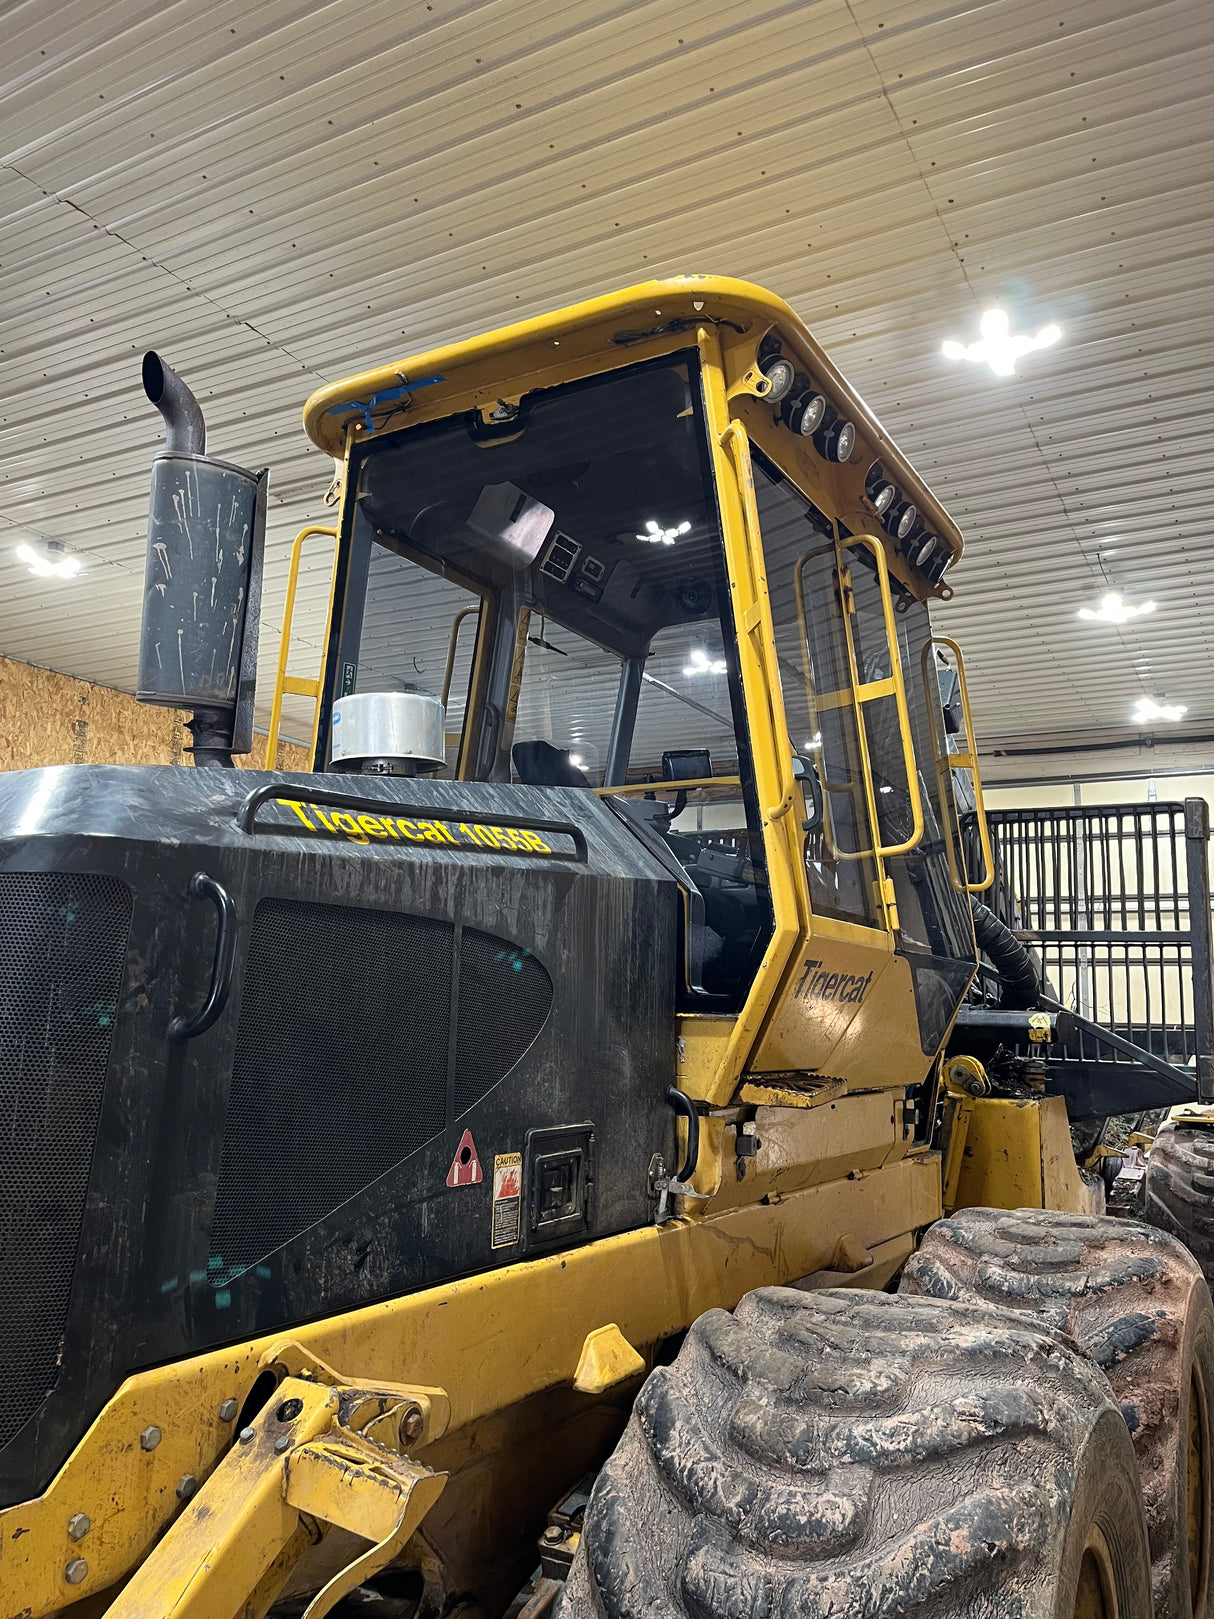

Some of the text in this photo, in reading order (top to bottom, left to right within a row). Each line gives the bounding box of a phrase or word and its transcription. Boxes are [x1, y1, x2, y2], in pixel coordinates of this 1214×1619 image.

[276, 799, 551, 854] Tigercat 1055B
[794, 959, 873, 1003] Tigercat
[495, 1155, 522, 1166] CAUTION
